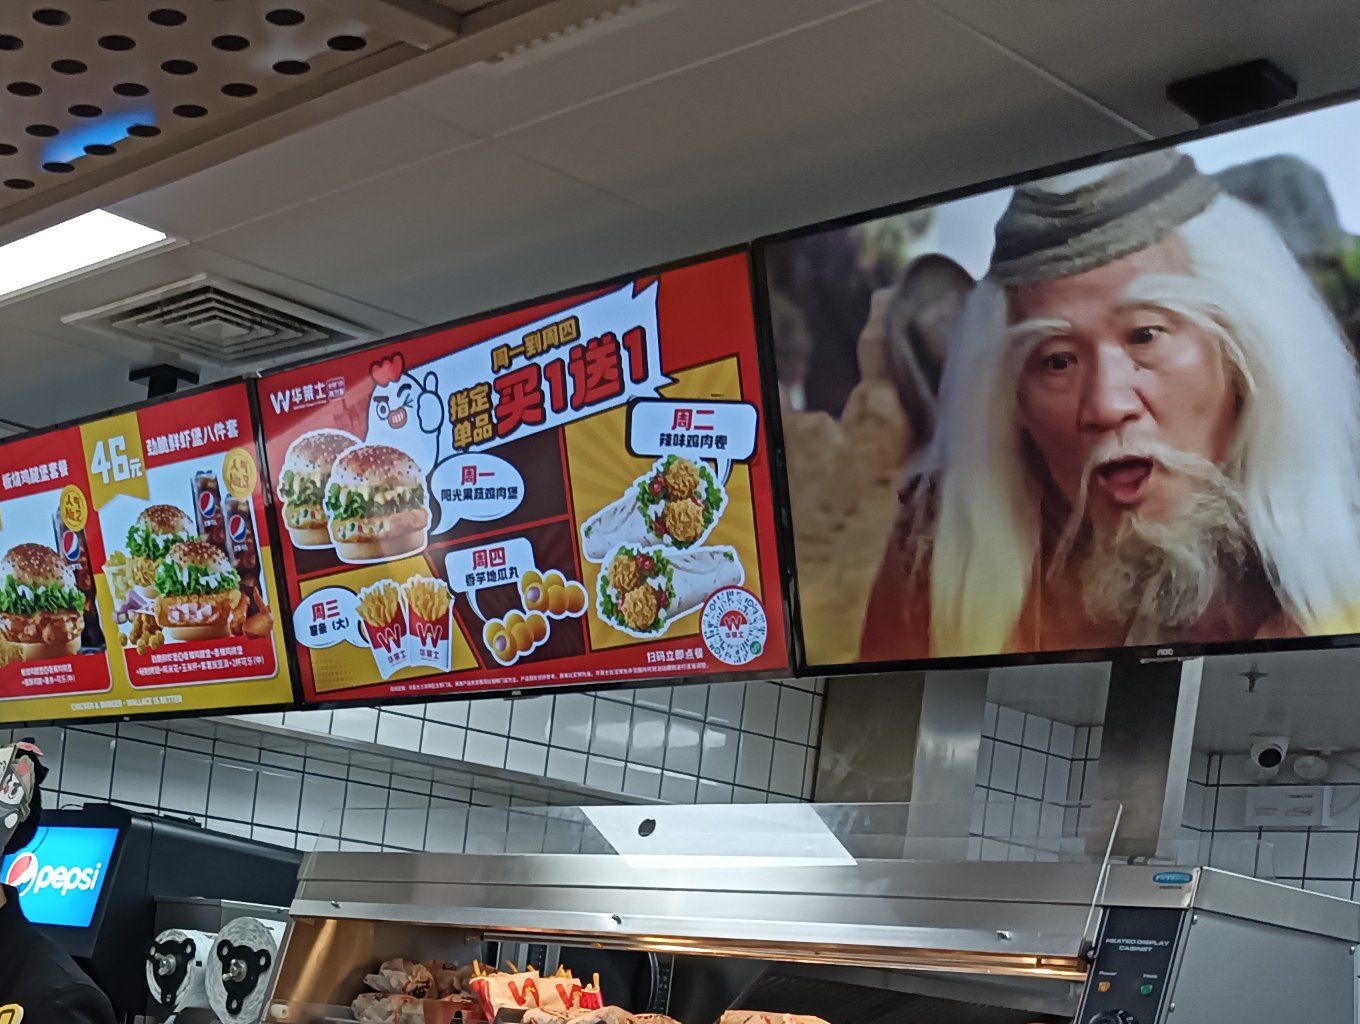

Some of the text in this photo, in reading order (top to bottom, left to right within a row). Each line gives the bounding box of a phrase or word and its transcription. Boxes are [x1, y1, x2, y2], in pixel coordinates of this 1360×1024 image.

[492, 316, 580, 372] 周一到周四
[493, 326, 650, 438] 买1送1
[291, 383, 328, 405] 华莱士
[449, 382, 492, 422] 指定
[452, 413, 494, 450] 单品
[671, 408, 716, 432] 周二
[659, 432, 728, 450] 辣味鸡肉卷
[90, 435, 144, 484] 46元
[460, 464, 496, 486] 周一
[440, 485, 519, 502] 阳光果蔬鸡肉堡
[471, 547, 507, 571] 周四
[465, 567, 520, 588] 香芋地瓜丸
[311, 599, 341, 622] 周三
[646, 646, 705, 664] 扫码立即点餐
[37, 861, 103, 895] pepsi
[1105, 937, 1170, 947] HEATED DISPLAY
[1117, 945, 1153, 953] CABINET
